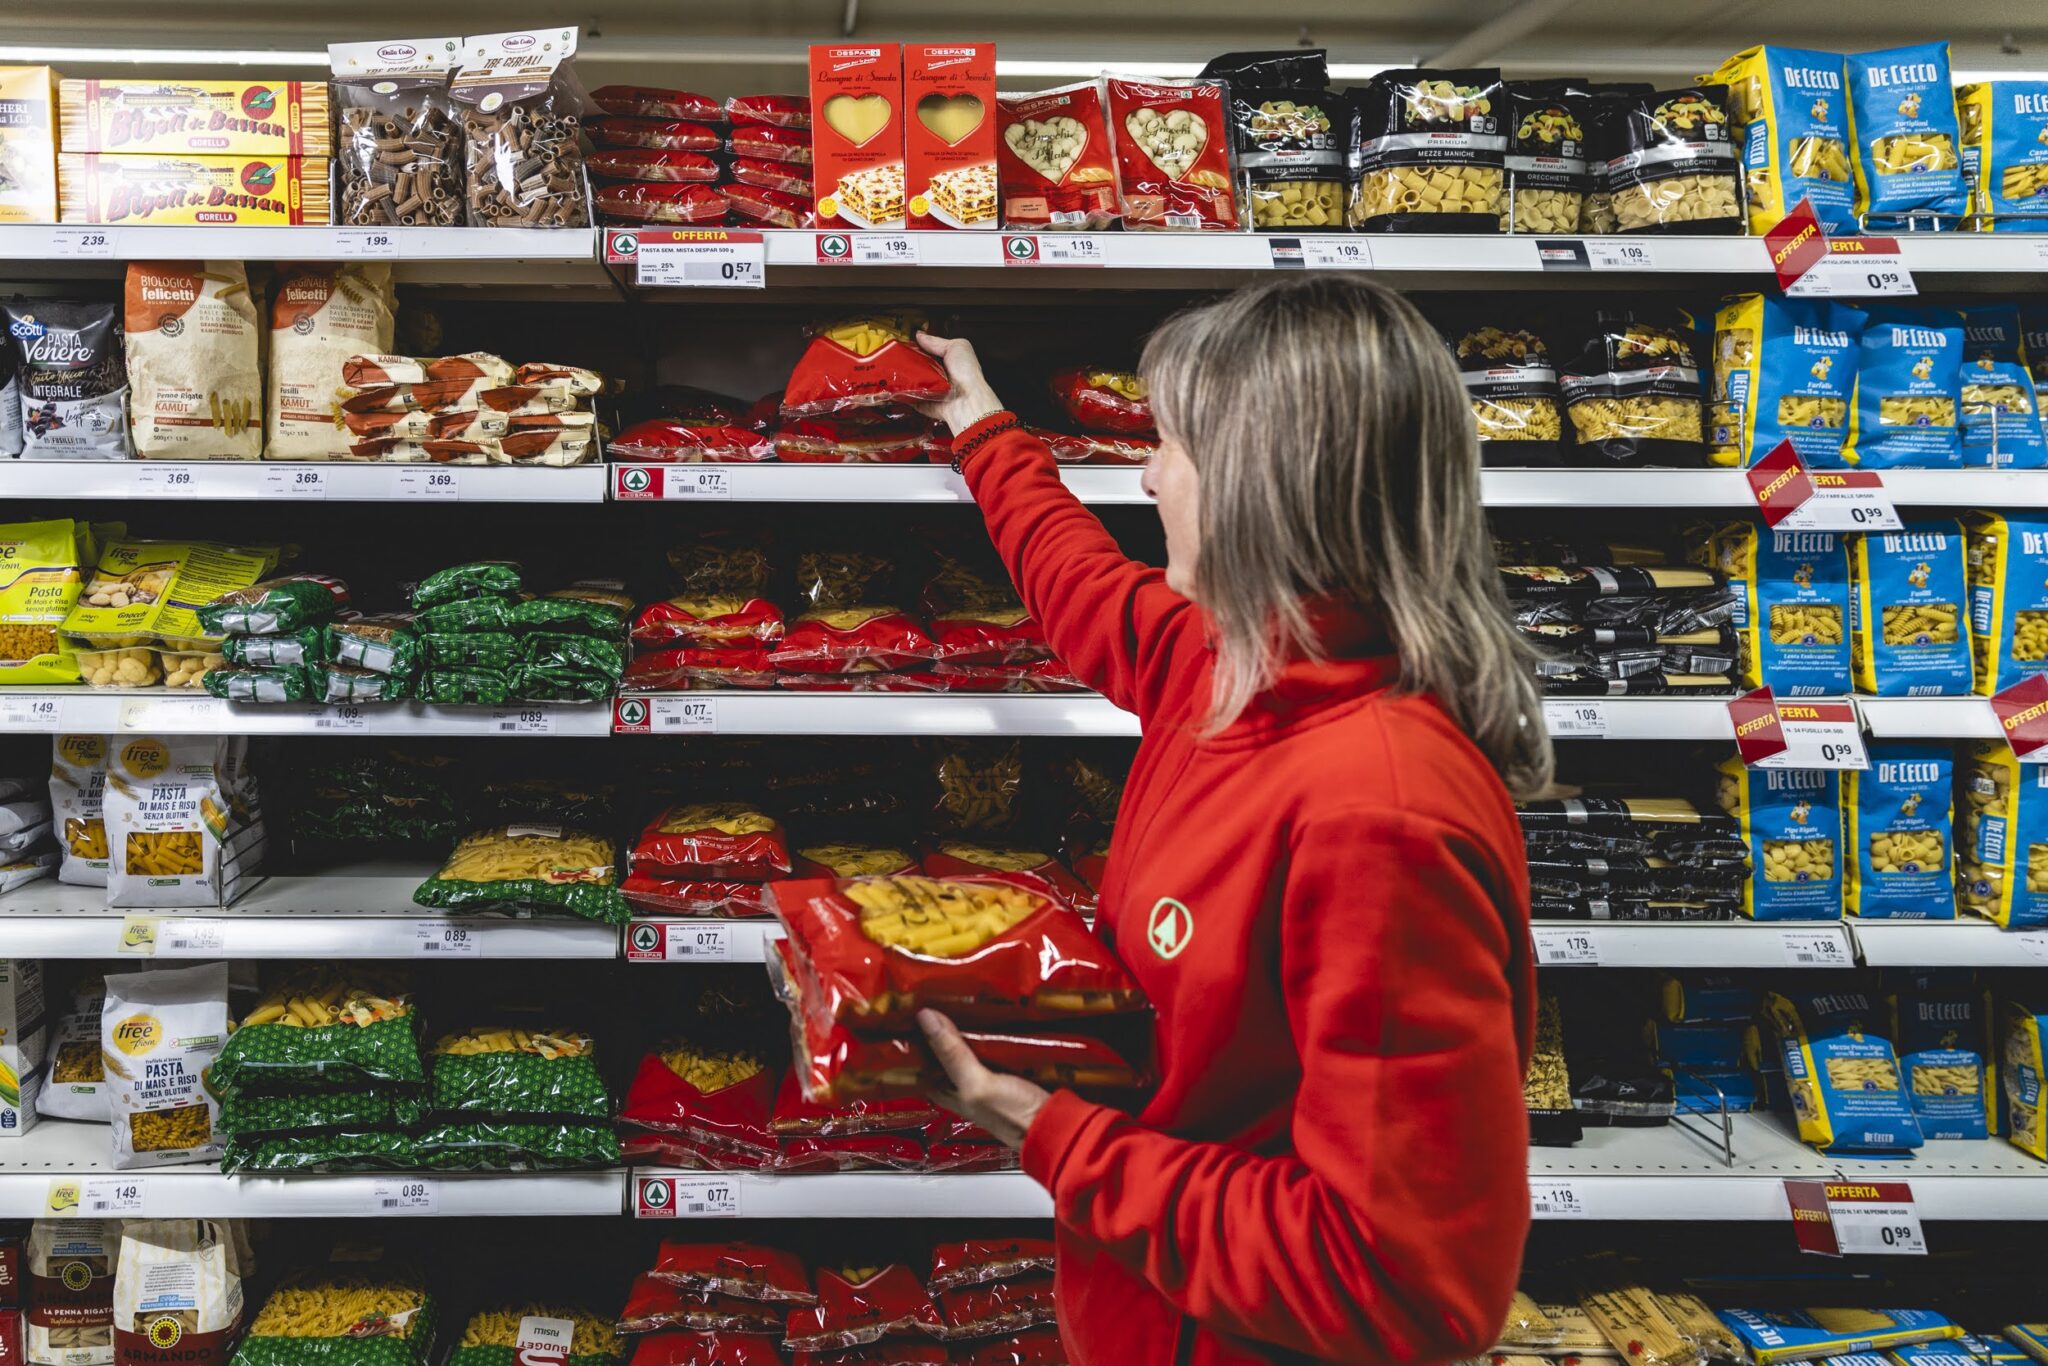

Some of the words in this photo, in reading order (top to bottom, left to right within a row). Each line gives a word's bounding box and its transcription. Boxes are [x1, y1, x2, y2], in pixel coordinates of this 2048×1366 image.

[484, 58, 502, 68] TRE
[504, 55, 542, 66] CEREALI
[817, 71, 852, 84] Lasagne
[855, 73, 863, 82] di
[911, 69, 946, 84] Lasagne
[950, 72, 958, 81] di
[1784, 67, 1801, 88] DE
[1801, 68, 1840, 90] CECCO
[1868, 67, 1889, 88] DE
[1890, 63, 1939, 85] CECCO
[2015, 94, 2033, 114] DE
[109, 107, 187, 146] Bigoli
[188, 115, 206, 131] de
[207, 110, 286, 138] Bassan
[191, 138, 226, 147] BORELLA
[1418, 150, 1444, 158] MEZZE
[1446, 150, 1475, 158] MANICHE
[1673, 158, 1718, 169] ORECCHIETTE
[1527, 174, 1570, 182] ORECCHIETTE
[106, 182, 185, 222] Bigoli
[187, 189, 205, 206] de
[207, 185, 286, 215] Bassan
[199, 213, 234, 222] BORELLA
[81, 235, 105, 247] 2,39
[366, 236, 388, 247] 1,99
[672, 231, 728, 241] OFFERTA
[885, 241, 907, 252] 1,99
[1071, 240, 1093, 251] 1,19
[1775, 224, 1817, 265] OFFERTA
[1336, 246, 1359, 257] 1,09
[1620, 247, 1643, 258] 1,09
[661, 262, 674, 270] 25%
[721, 262, 752, 281] 0,57
[141, 275, 193, 289] BIOLOGICA
[1867, 273, 1900, 291] 0,99
[142, 288, 195, 302] felicetti
[286, 288, 328, 301] felicetti
[11, 323, 43, 337] Scotti
[47, 332, 82, 349] PASTA
[1794, 326, 1810, 346] DE
[1811, 327, 1849, 348] CECCO
[1892, 328, 1910, 347] DE
[1910, 328, 1947, 348] CECCO
[22, 336, 90, 364] Venere
[32, 385, 82, 399] INTEGRALE
[157, 392, 179, 400] Penne
[180, 392, 203, 400] Rigate
[280, 387, 299, 395] Fusilli
[155, 402, 188, 413] KAMUT
[280, 399, 309, 408] KAMUT
[168, 474, 190, 485] 3,69
[296, 473, 318, 485] 3,69
[428, 474, 451, 486] 3,69
[699, 475, 721, 486] 0,77
[1759, 464, 1801, 502] OFFERTA
[1852, 508, 1883, 524] 0,99
[1774, 533, 1791, 553] DE
[1793, 533, 1834, 552] CECCO
[1885, 534, 1903, 553] DE
[1904, 533, 1947, 552] CECCO
[2023, 532, 2041, 555] DE
[110, 547, 138, 559] free
[29, 586, 63, 598] Pasta
[117, 610, 148, 620] Gnocchi
[1791, 686, 1800, 696] DE
[1800, 686, 1825, 695] CECCO
[1908, 686, 1918, 696] DE
[1918, 686, 1943, 695] CECCO
[31, 703, 54, 714] 1,49
[337, 707, 358, 719] 1,09
[684, 704, 706, 717] 0,77
[1780, 708, 1819, 718] FERTA
[521, 711, 542, 723] 0,89
[1575, 709, 1597, 722] 1,09
[1736, 713, 1776, 737] OFFERTA
[63, 736, 97, 751] free
[126, 748, 160, 763] free
[1822, 744, 1851, 763] 0,99
[1767, 770, 1785, 790] DE
[1788, 769, 1826, 789] CECCO
[1879, 763, 1897, 783] DE
[1900, 763, 1939, 782] CECCO
[151, 787, 187, 800] PASTA
[138, 801, 148, 811] DI
[150, 801, 170, 811] MAIS
[171, 801, 176, 811] E
[178, 800, 196, 810] RISO
[144, 812, 164, 820] SENZA
[165, 811, 190, 819] GLUTINE
[129, 926, 148, 935] free
[444, 930, 466, 943] 0,89
[697, 933, 719, 946] 0,77
[1566, 938, 1589, 951] 1,79
[1813, 941, 1836, 954] 1,38
[1812, 997, 1828, 1016] DE
[1829, 993, 1870, 1013] CECCO
[1919, 1003, 1935, 1021] DE
[1936, 1002, 1970, 1020] CECCO
[118, 1025, 153, 1039] free
[146, 1062, 184, 1078] PASTA
[134, 1081, 144, 1091] DI
[145, 1079, 168, 1089] MAIS
[169, 1078, 175, 1087] E
[177, 1074, 198, 1086] RISO
[140, 1090, 163, 1099] SENZA
[164, 1086, 192, 1097] GLUTINE
[1864, 1132, 1876, 1143] DE
[1876, 1132, 1894, 1143] CECCO
[55, 1189, 74, 1198] free
[116, 1186, 137, 1201] 1,49
[402, 1184, 425, 1198] 0,89
[708, 1189, 730, 1202] 0,77
[1552, 1189, 1573, 1203] 1,19
[1825, 1186, 1880, 1200] OFFERTA
[1793, 1208, 1829, 1223] OFFERTA
[1881, 1226, 1911, 1247] 0,99
[44, 1307, 53, 1316] LA
[54, 1308, 82, 1316] PENNA
[83, 1307, 114, 1316] RIGATA
[534, 1328, 560, 1338] FUSILLI
[520, 1340, 568, 1354] BUDGET
[123, 1347, 210, 1363] ARMANDO
